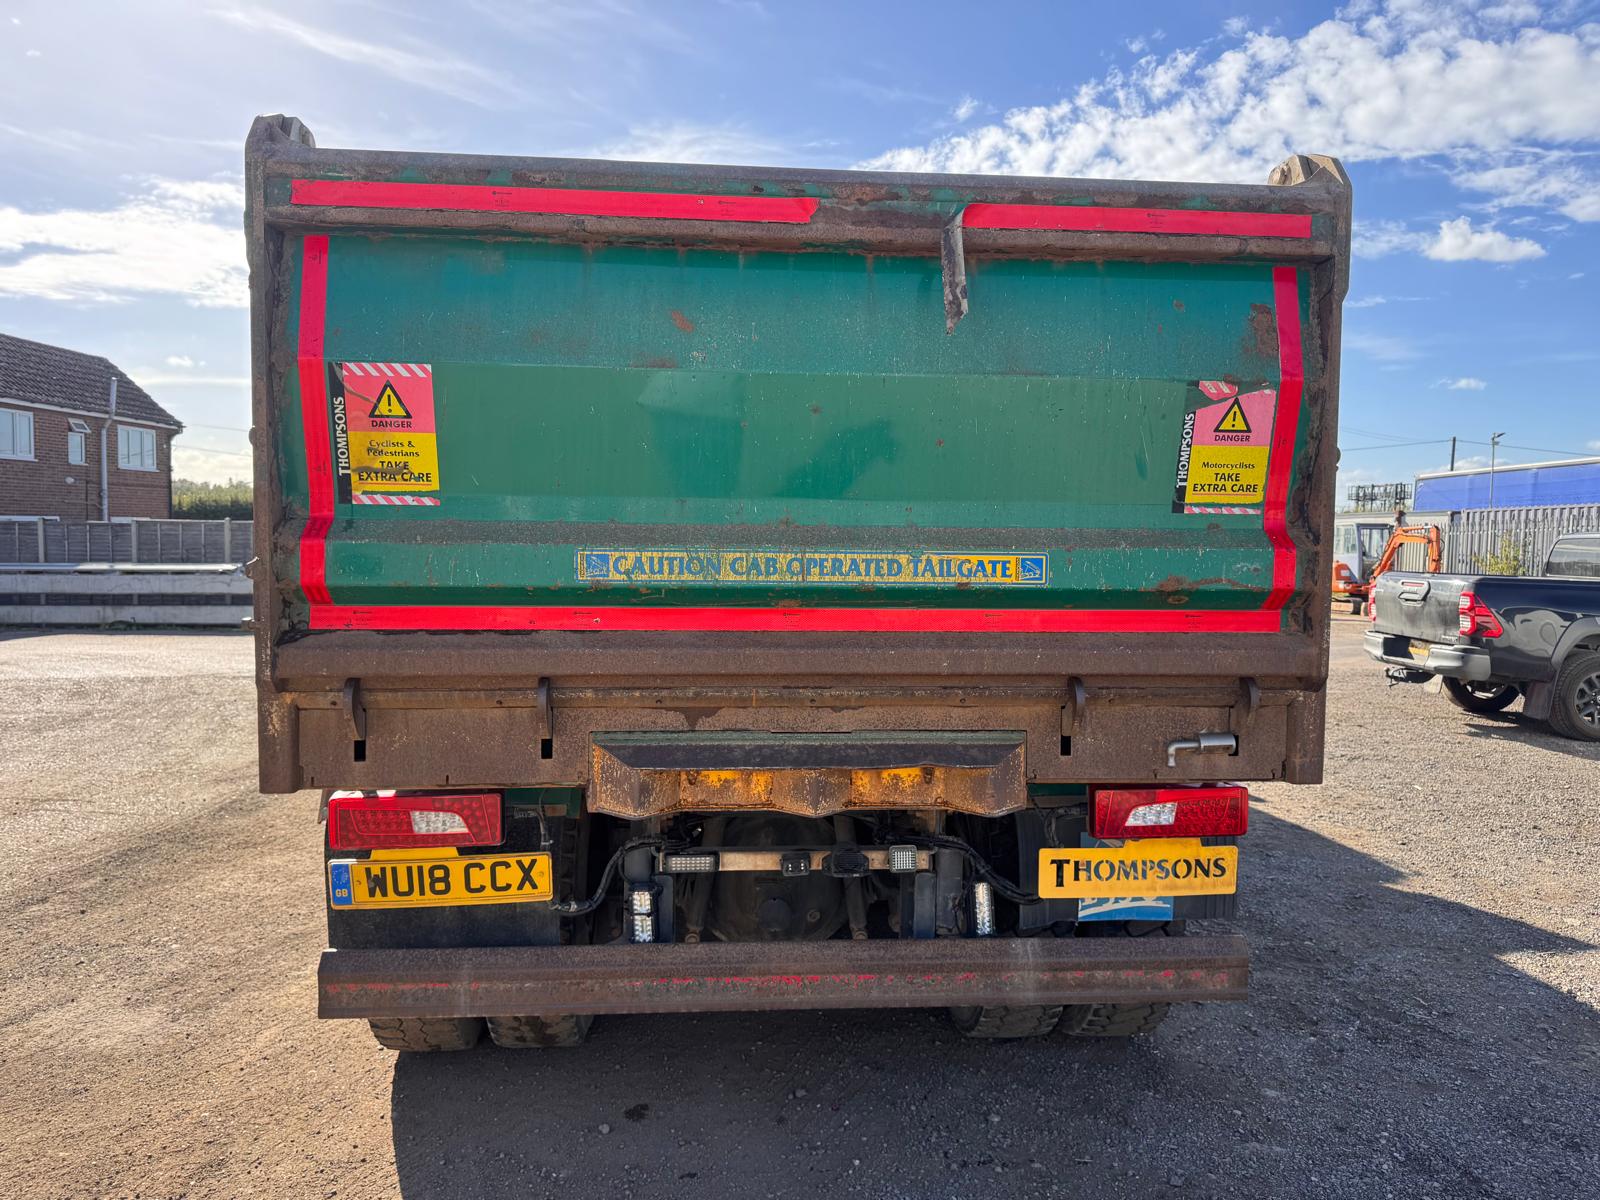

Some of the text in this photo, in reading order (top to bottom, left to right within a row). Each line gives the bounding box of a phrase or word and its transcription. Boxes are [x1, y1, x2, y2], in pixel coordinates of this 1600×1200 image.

[371, 420, 413, 429] DANGER
[333, 396, 349, 476] THOMPSONS
[1214, 434, 1251, 442] DANGER
[369, 440, 416, 449] Cyclists &
[367, 448, 420, 458] Pedestrians
[1176, 413, 1195, 488] THOMPSONS
[379, 461, 410, 470] TAKE
[1201, 461, 1256, 470] Motorcyclists
[358, 472, 432, 483] EXTRA CARE
[1214, 472, 1241, 482] TAKE
[1192, 483, 1259, 493] EXTRA CARE
[612, 556, 721, 576] CAUTION
[729, 556, 779, 577] CAB
[786, 557, 901, 577] OPERATED
[910, 558, 1013, 578] TAILGATE
[1050, 857, 1227, 888] THOMPSONS
[365, 858, 538, 898] WU18 CCX
[335, 888, 348, 897] GB
